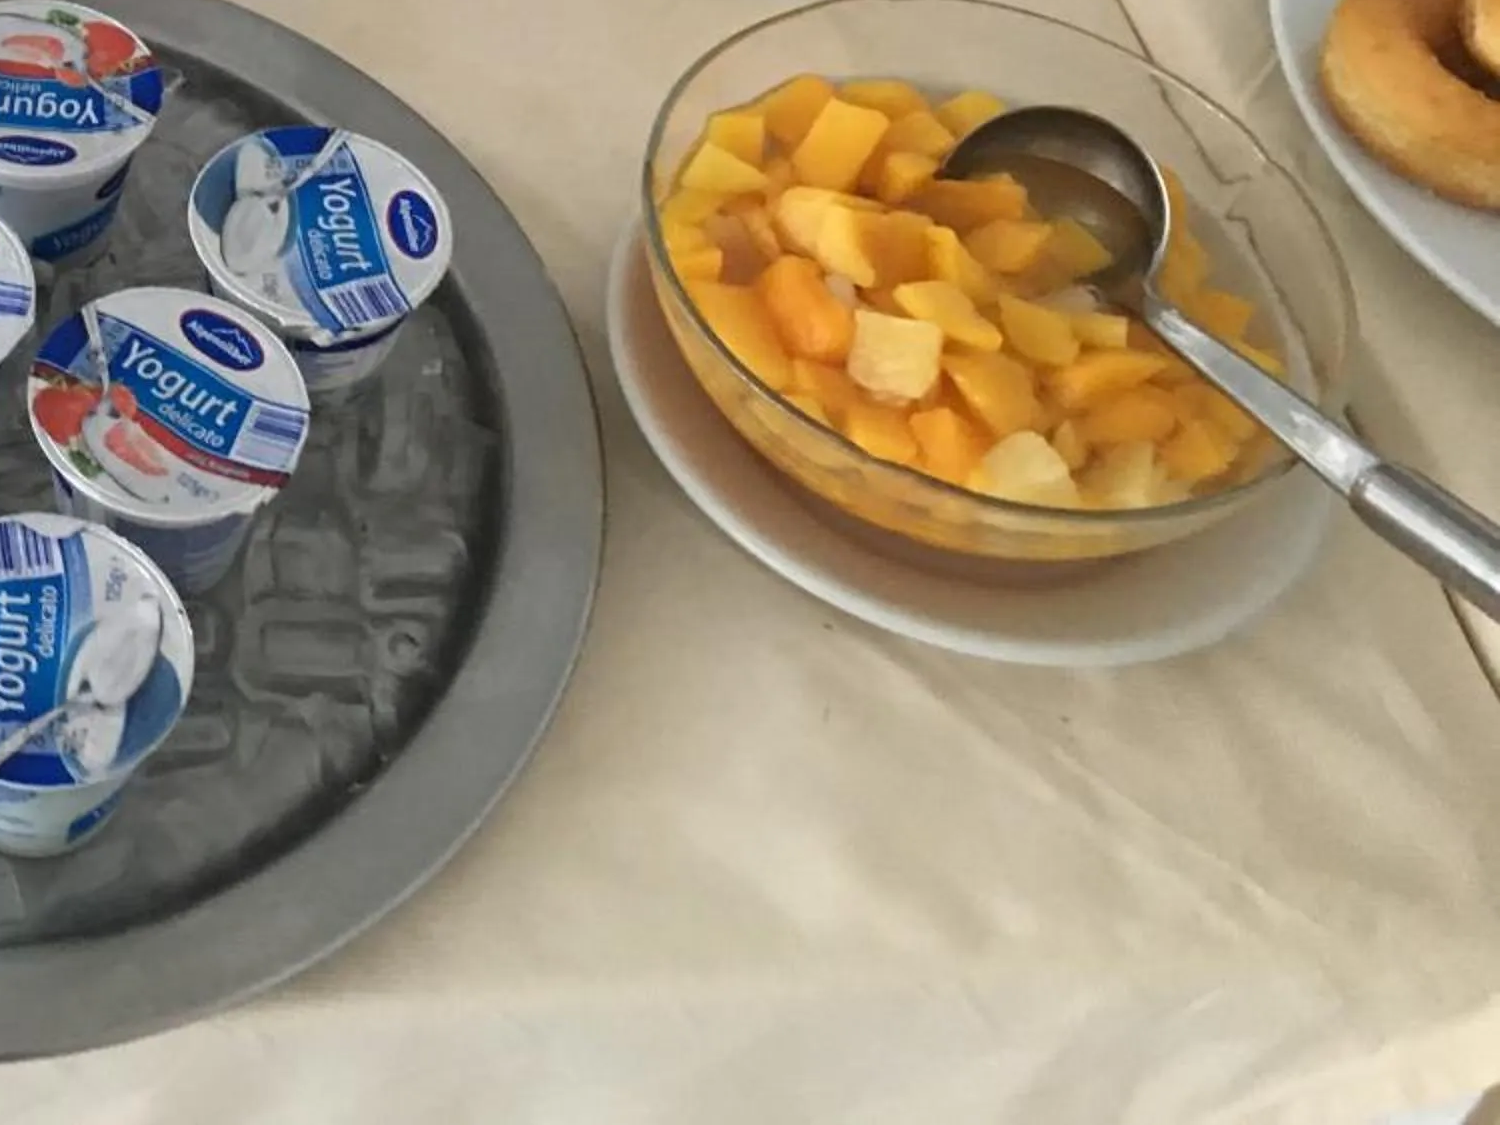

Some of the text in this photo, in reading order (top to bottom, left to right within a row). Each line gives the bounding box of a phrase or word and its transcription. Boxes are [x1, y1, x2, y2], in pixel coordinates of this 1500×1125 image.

[307, 228, 333, 280] delicato
[317, 178, 373, 272] Yogurt
[120, 338, 238, 426] Yogurt
[158, 402, 225, 448] delicato
[34, 585, 57, 658] delicato
